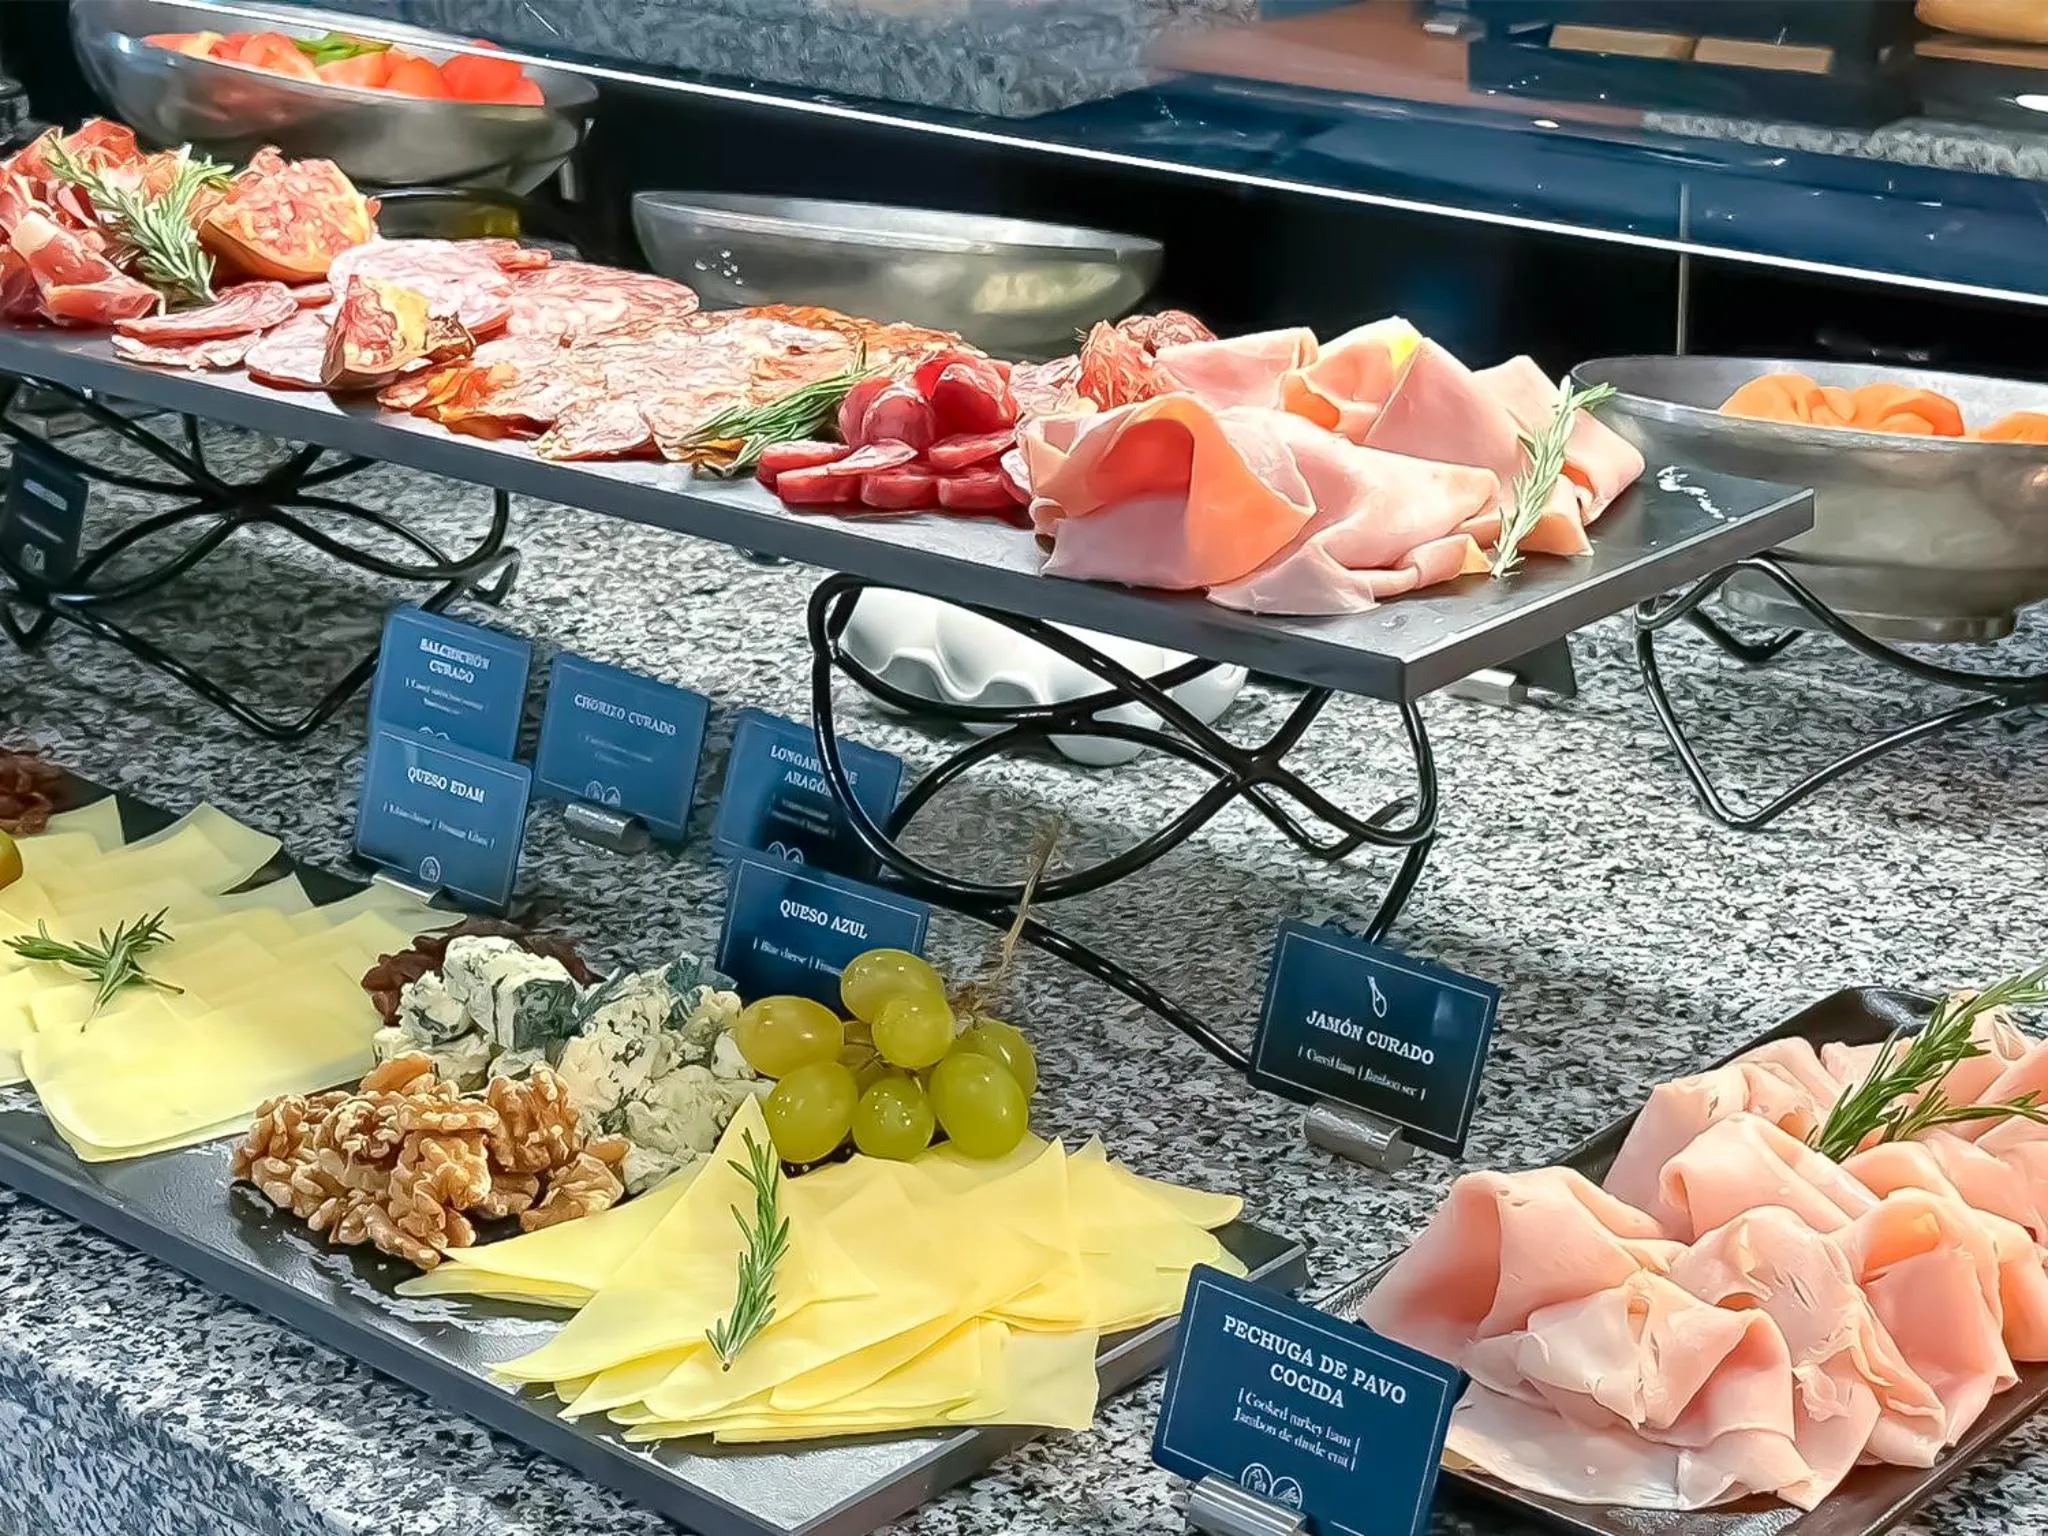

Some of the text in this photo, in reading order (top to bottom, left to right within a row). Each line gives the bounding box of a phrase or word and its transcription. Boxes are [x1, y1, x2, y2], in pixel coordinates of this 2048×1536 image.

[429, 659, 475, 684] CURADO
[574, 693, 677, 736] CHORIZO CURADO
[407, 766, 485, 803] QUESO EDAM
[780, 899, 868, 940] QUESO AZUL
[1306, 1010, 1434, 1065] JAMÓN CURADO
[1223, 1314, 1406, 1404] PECHUGA DE PAVO
[1270, 1363, 1344, 1408] COCIDA
